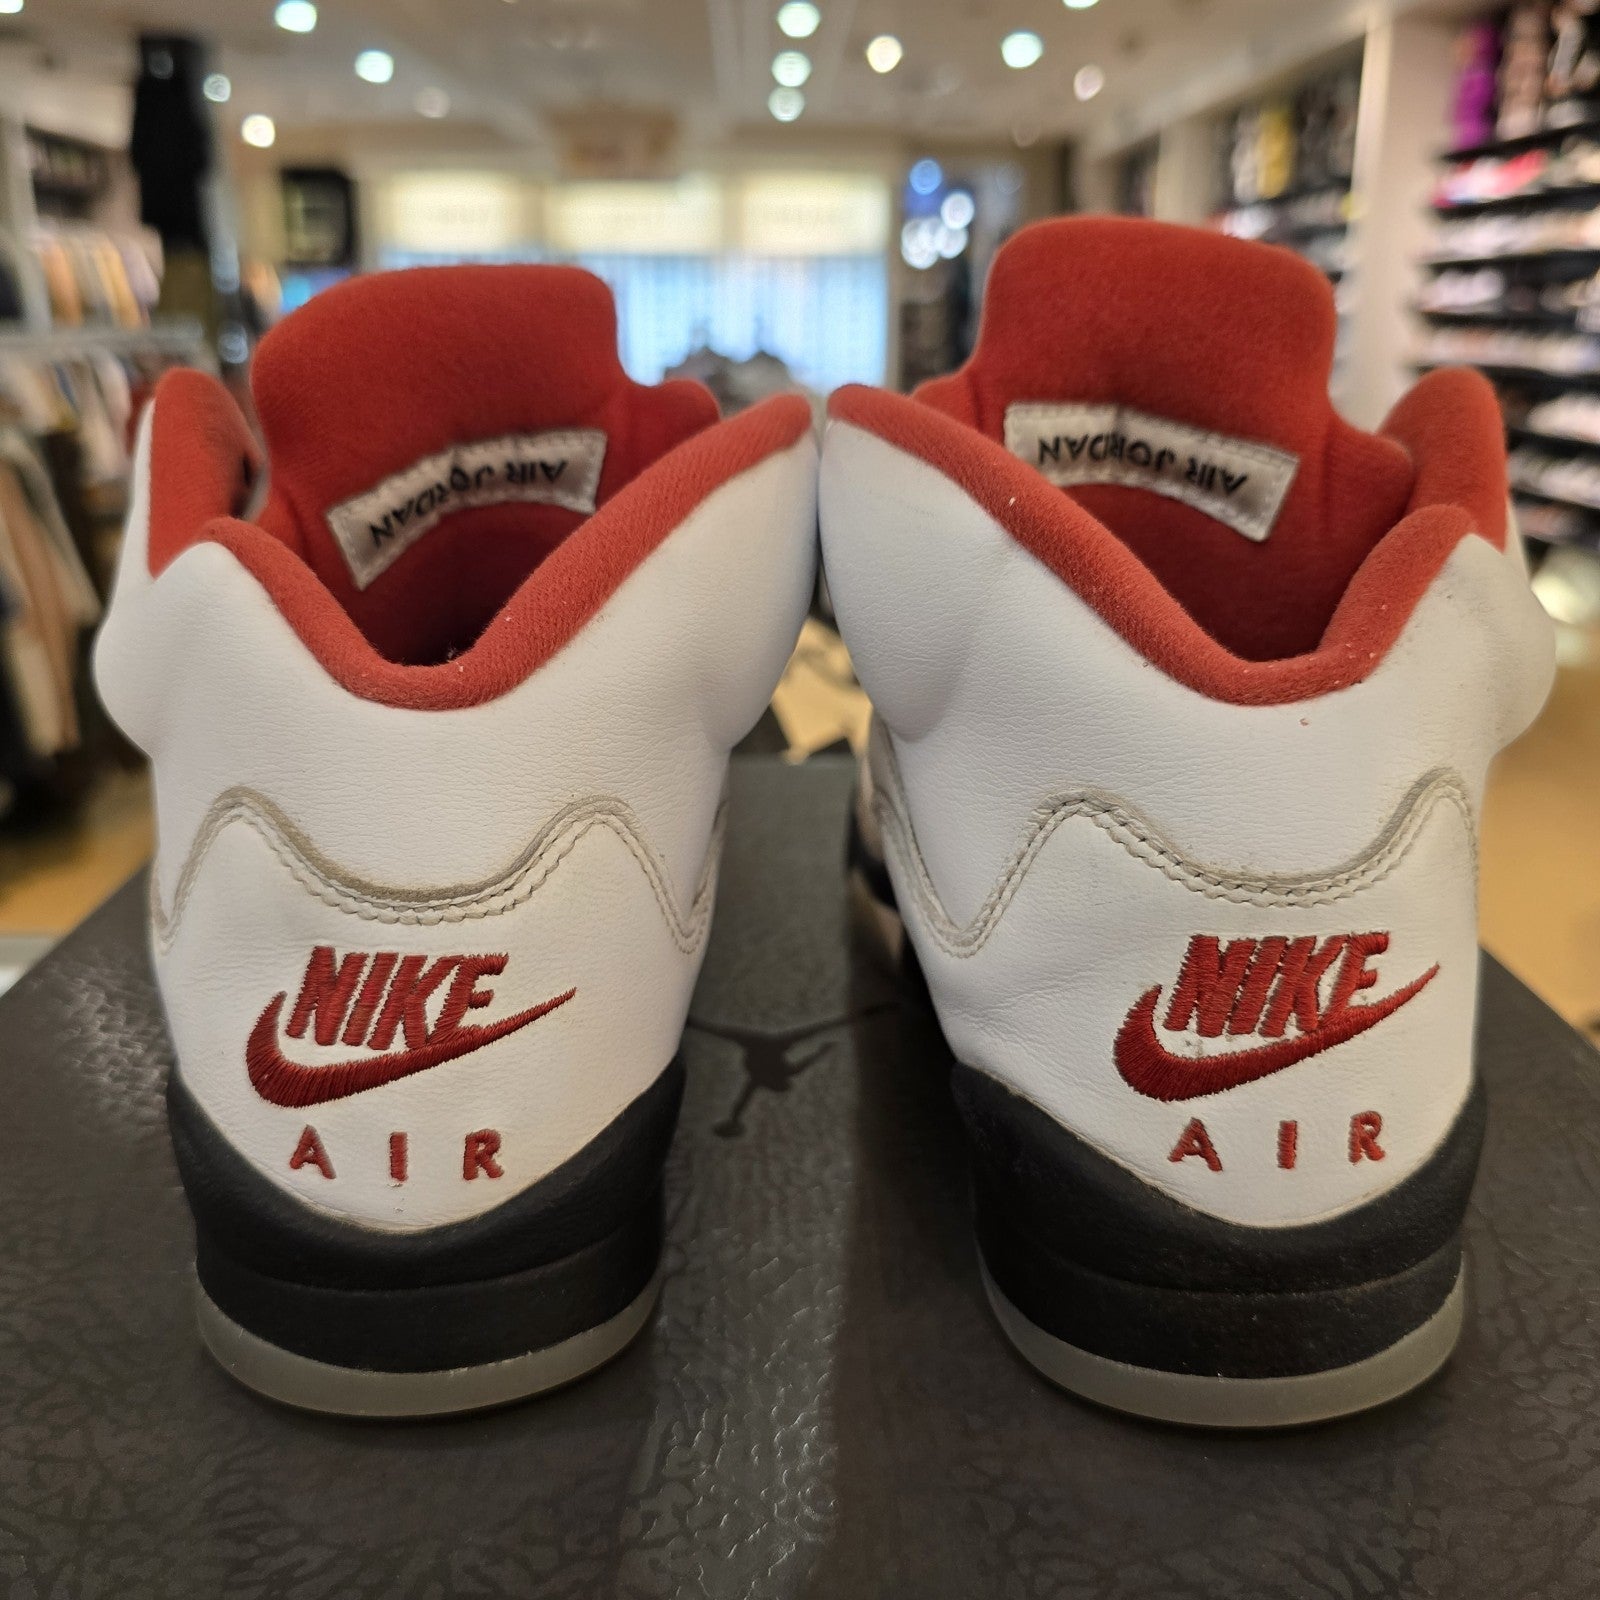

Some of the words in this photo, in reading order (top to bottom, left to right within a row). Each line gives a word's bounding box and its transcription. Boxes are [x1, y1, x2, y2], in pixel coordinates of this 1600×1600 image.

[504, 459, 568, 485] AIR
[1037, 431, 1176, 473] JORDAN
[1186, 457, 1248, 497] AIR
[368, 463, 496, 548] JORDAN
[285, 945, 509, 1050] NIKE
[1162, 930, 1390, 1038] NIKE
[289, 1124, 505, 1182] AIR
[1167, 1110, 1386, 1173] AIR
